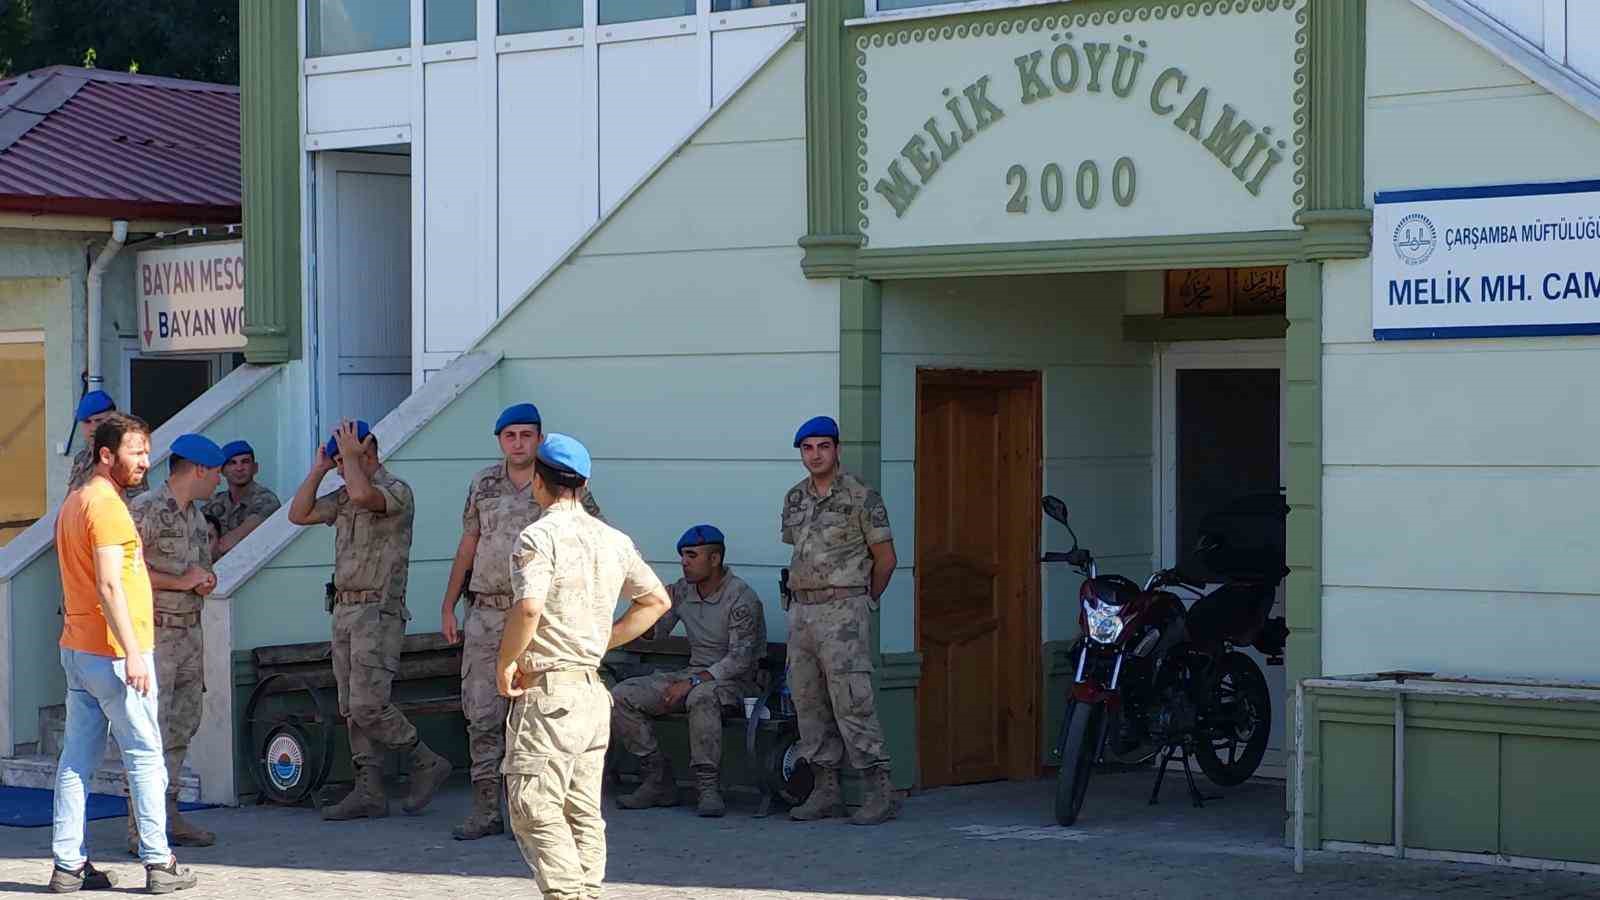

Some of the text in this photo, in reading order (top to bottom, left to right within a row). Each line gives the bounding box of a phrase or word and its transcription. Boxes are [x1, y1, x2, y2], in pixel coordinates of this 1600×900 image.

[874, 32, 1286, 218] MELİK KÖYÜ CAMİİ
[1006, 157, 1137, 213] 2000
[1445, 224, 1518, 251] ÇARŞAMBA
[142, 261, 195, 296] BAYAN
[1389, 270, 1472, 306] MELİK
[1481, 274, 1532, 302] MH.
[158, 308, 216, 338] BAYAN
